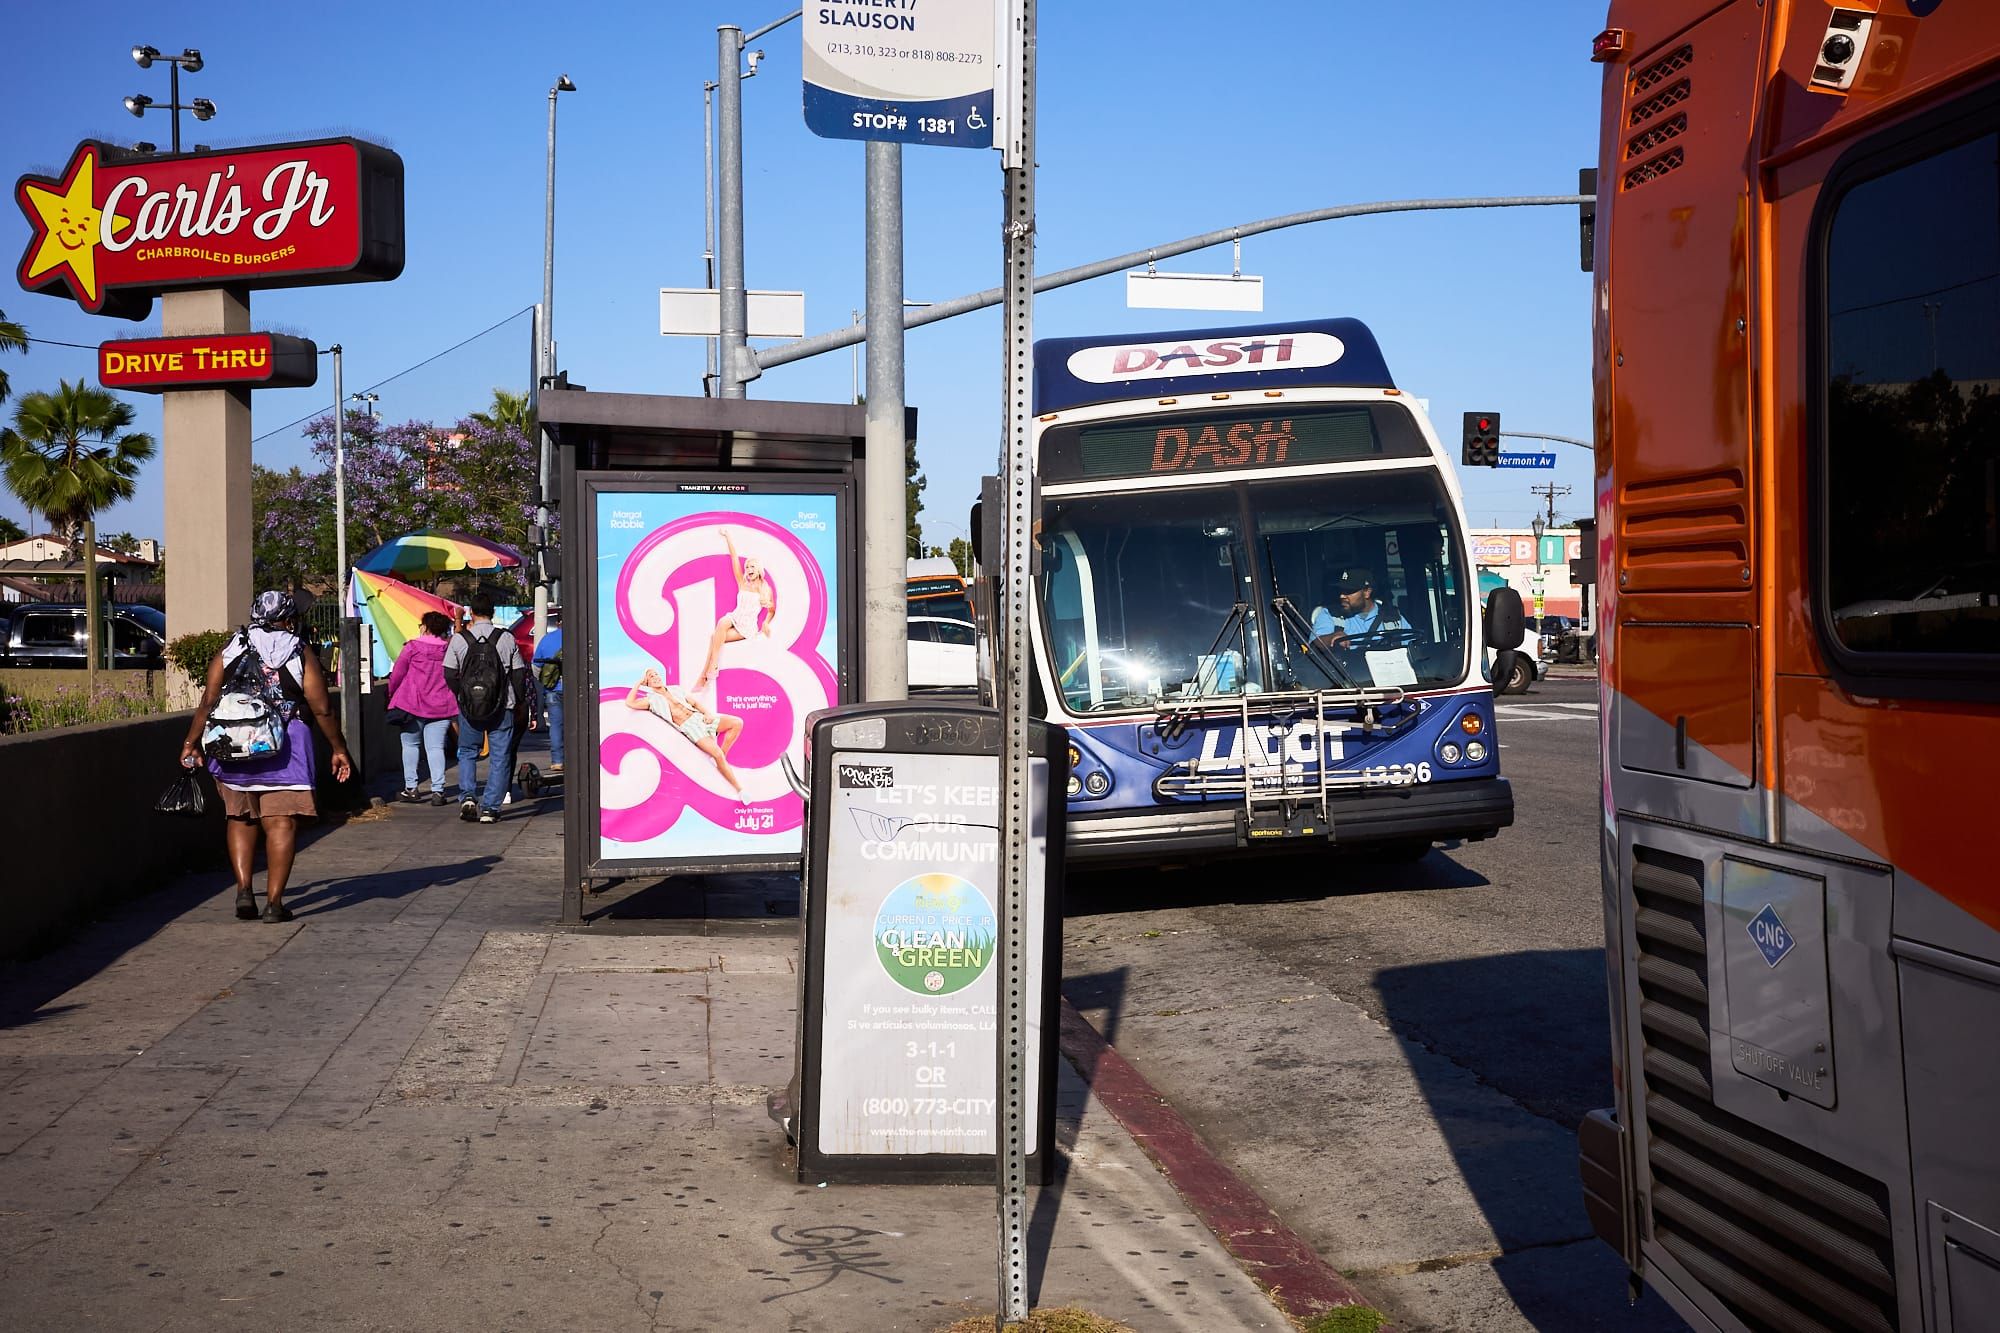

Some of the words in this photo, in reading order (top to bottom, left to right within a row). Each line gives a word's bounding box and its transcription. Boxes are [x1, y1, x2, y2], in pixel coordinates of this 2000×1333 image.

[819, 9, 915, 31] SLAUSON
[827, 42, 852, 55] (213,
[855, 45, 876, 57] 310,
[878, 47, 897, 58] 323
[899, 50, 909, 58] or
[912, 49, 934, 61] 818)
[936, 51, 983, 64] 808-2273
[852, 112, 907, 130] STOP#
[918, 117, 955, 134] 1381
[100, 164, 251, 252] Carl's
[252, 160, 335, 240] Jr
[136, 248, 231, 264] CHARBROILED
[233, 245, 296, 266] BURGERS
[105, 351, 183, 375] DRIVE
[192, 347, 266, 371] THRU
[1112, 337, 1295, 375] DASH
[1150, 420, 1297, 471] DASH
[1498, 456, 1536, 466] Vermont
[1539, 458, 1551, 466] Av
[610, 520, 645, 529] Robbie
[798, 511, 818, 520] Ryan
[875, 784, 936, 806] LET'S
[735, 815, 760, 830] July
[760, 814, 774, 828] 21
[913, 812, 968, 834] OUR
[861, 840, 999, 863] COMMUNIT
[879, 914, 924, 925] CURREN
[882, 929, 965, 949] CLEAN
[1756, 920, 1784, 949] CNG
[899, 948, 982, 968] GREEN
[863, 1004, 871, 1014] If
[872, 1005, 890, 1016] you
[893, 1005, 910, 1014] see
[912, 1004, 938, 1016] bulky
[906, 1041, 955, 1058] 3-1-1
[915, 1066, 946, 1083] OR
[1739, 1044, 1764, 1066] SHUT
[1766, 1055, 1785, 1073] OFF
[1788, 1063, 1821, 1090] VALVE
[862, 1098, 909, 1117] (800)
[913, 1098, 997, 1115] 773-CITY
